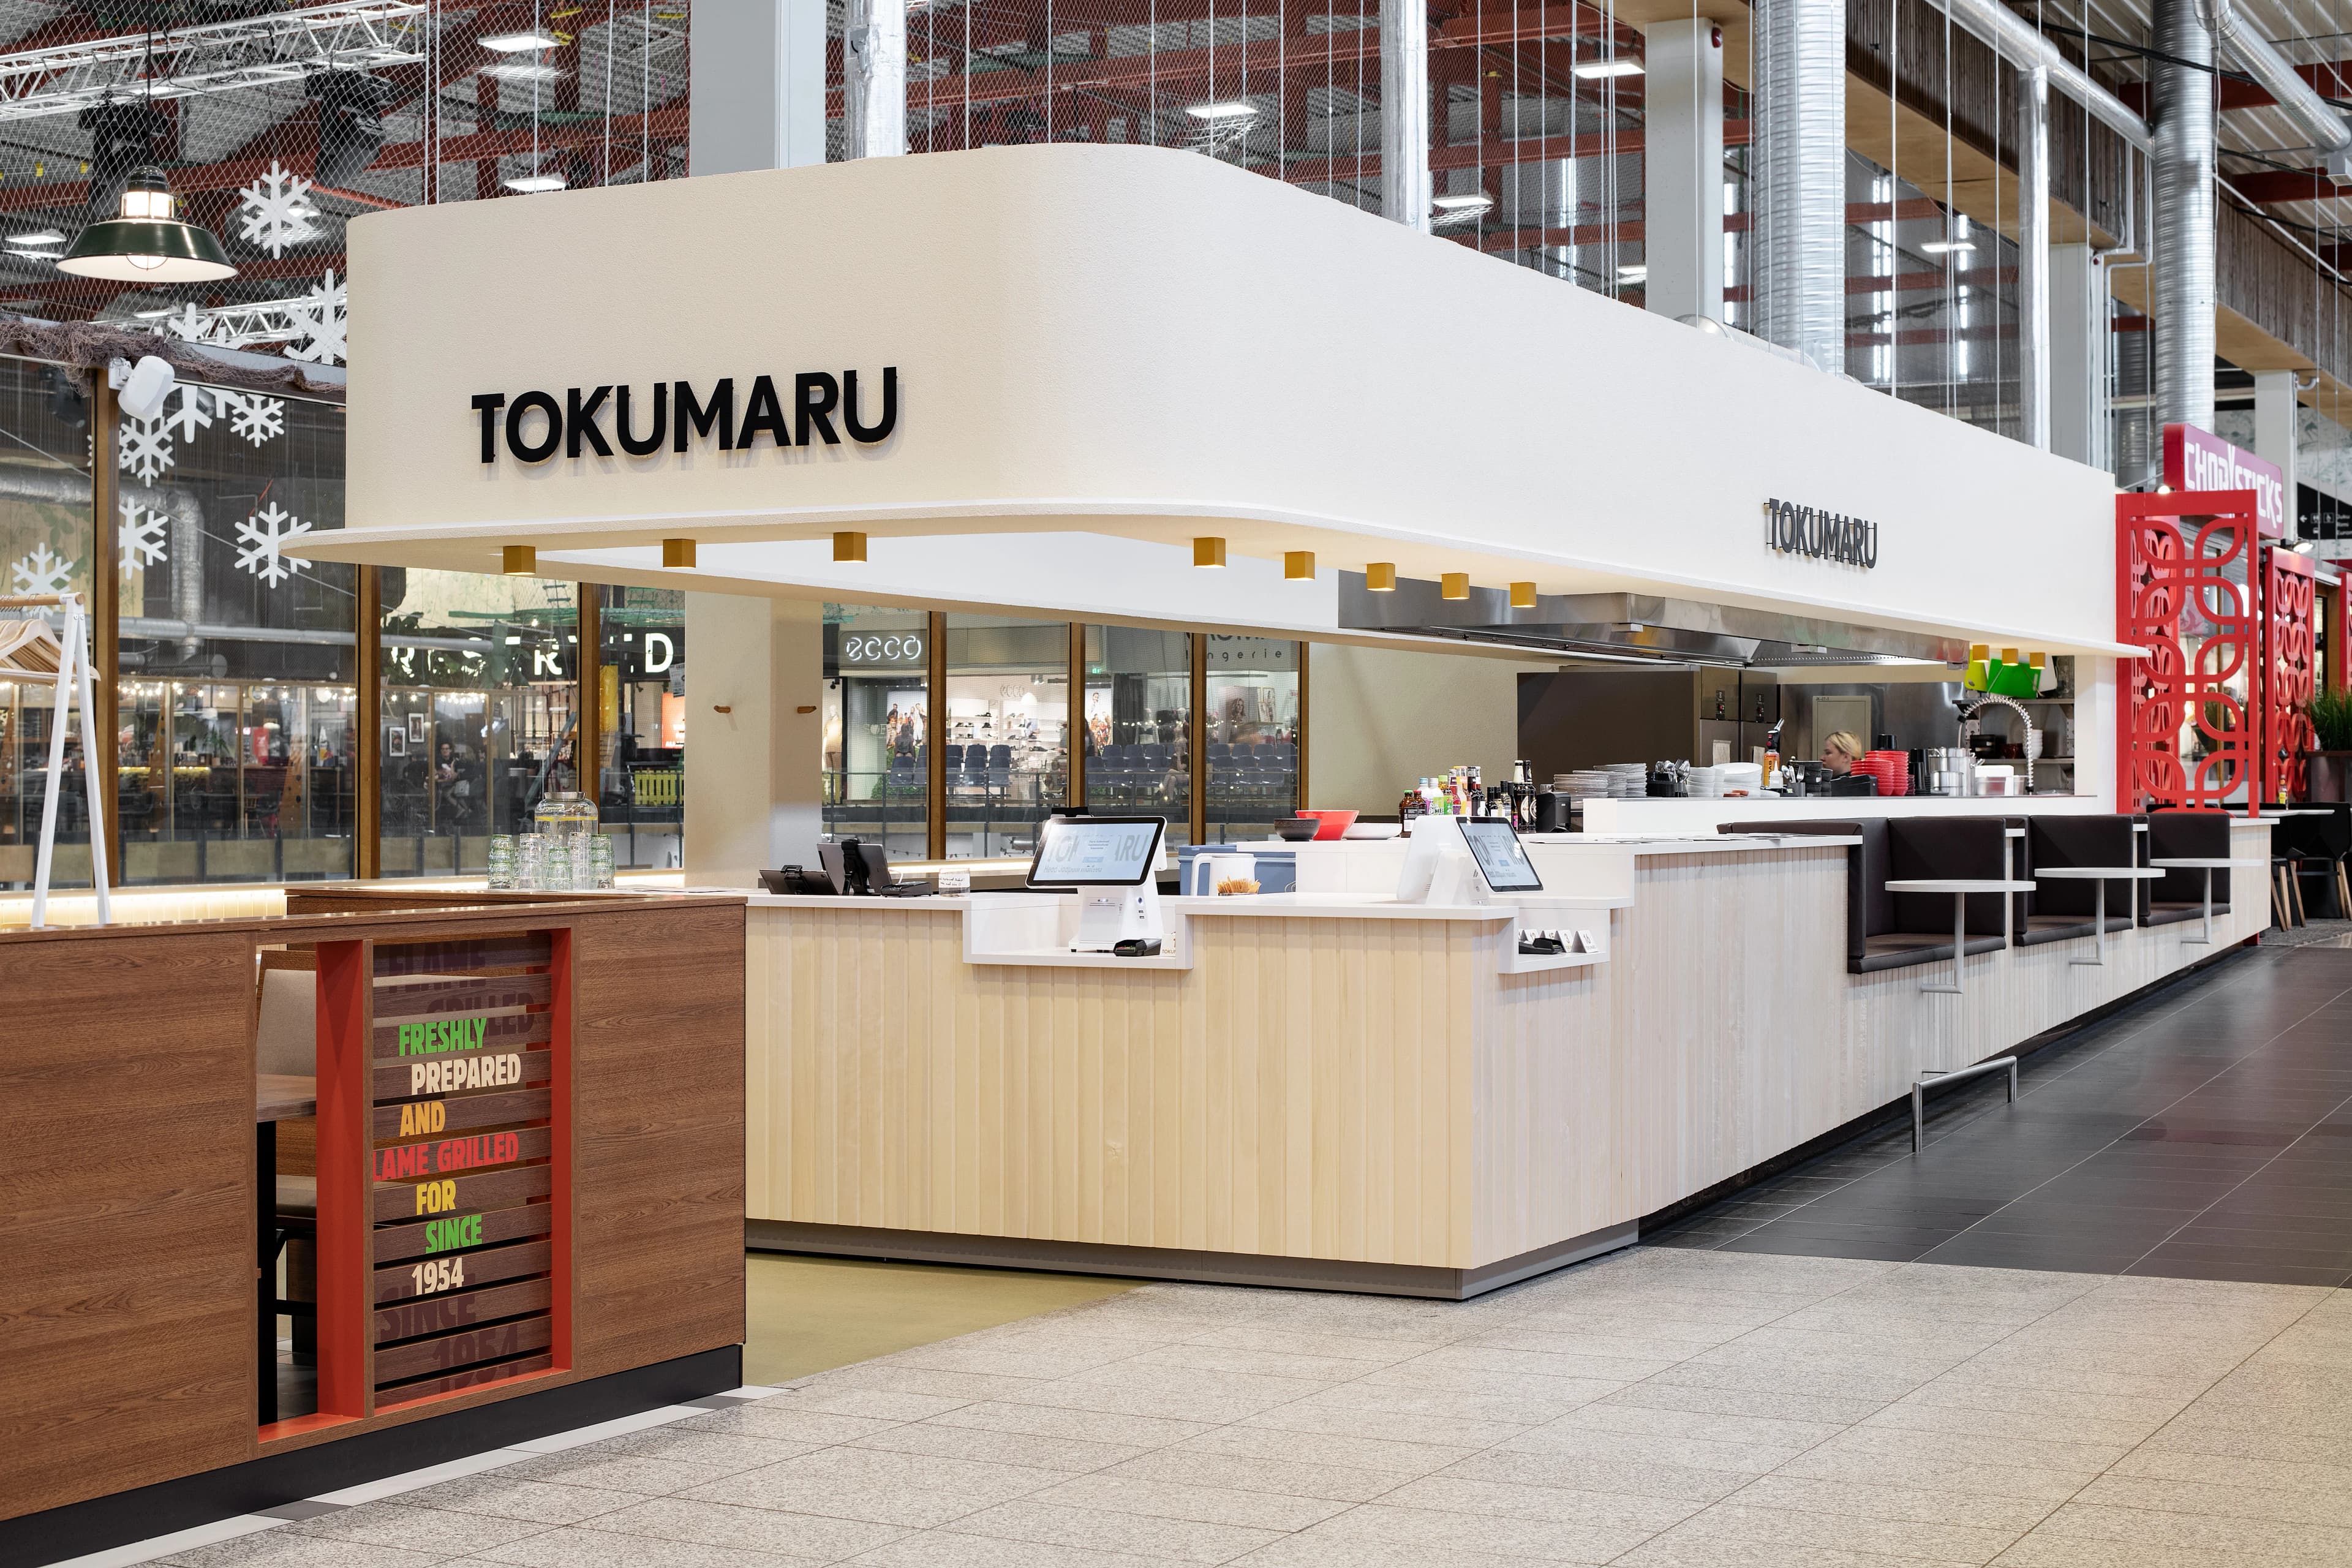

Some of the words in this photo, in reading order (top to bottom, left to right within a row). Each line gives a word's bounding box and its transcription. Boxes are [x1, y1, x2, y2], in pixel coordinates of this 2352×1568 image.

[472, 366, 897, 463] TOKUMARU
[1770, 498, 1877, 568] TOKUMARU
[1186, 648, 1282, 662] lngerie
[399, 1017, 487, 1056] FRESHLY
[412, 1054, 521, 1095] PREPARED
[400, 1102, 446, 1137] AND
[373, 1144, 429, 1182] LAME
[437, 1133, 519, 1172] GRILLED
[417, 1180, 456, 1215] FOR
[426, 1215, 482, 1254] SINCE
[412, 1257, 464, 1295] 1954
